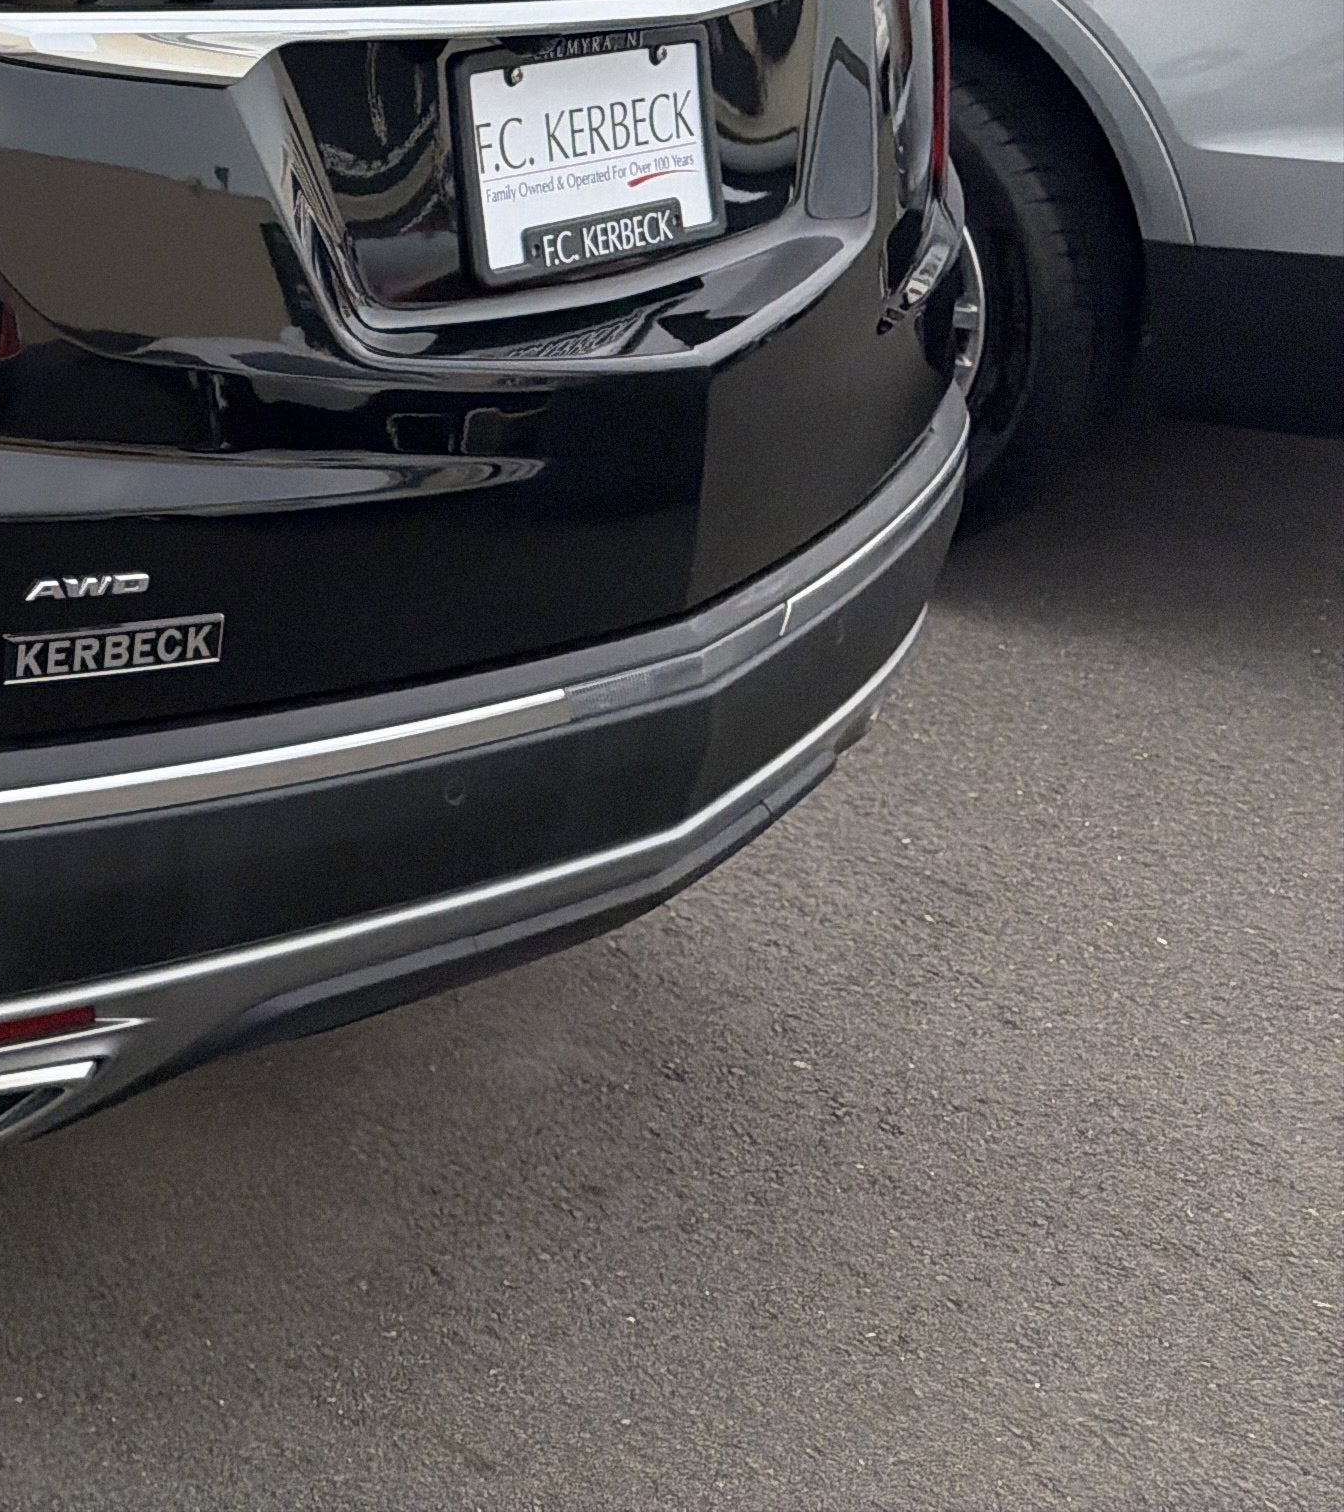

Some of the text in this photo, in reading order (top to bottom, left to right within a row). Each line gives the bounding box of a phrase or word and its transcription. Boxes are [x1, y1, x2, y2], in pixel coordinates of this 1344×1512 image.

[627, 30, 644, 48] NJ
[475, 89, 694, 175] F.C. KERBECK
[486, 153, 694, 203] Family Owned & Operated For Over 100 Years
[542, 209, 674, 267] F.C. KERBECK
[25, 572, 150, 601] AWD
[15, 624, 213, 678] KERBECK
